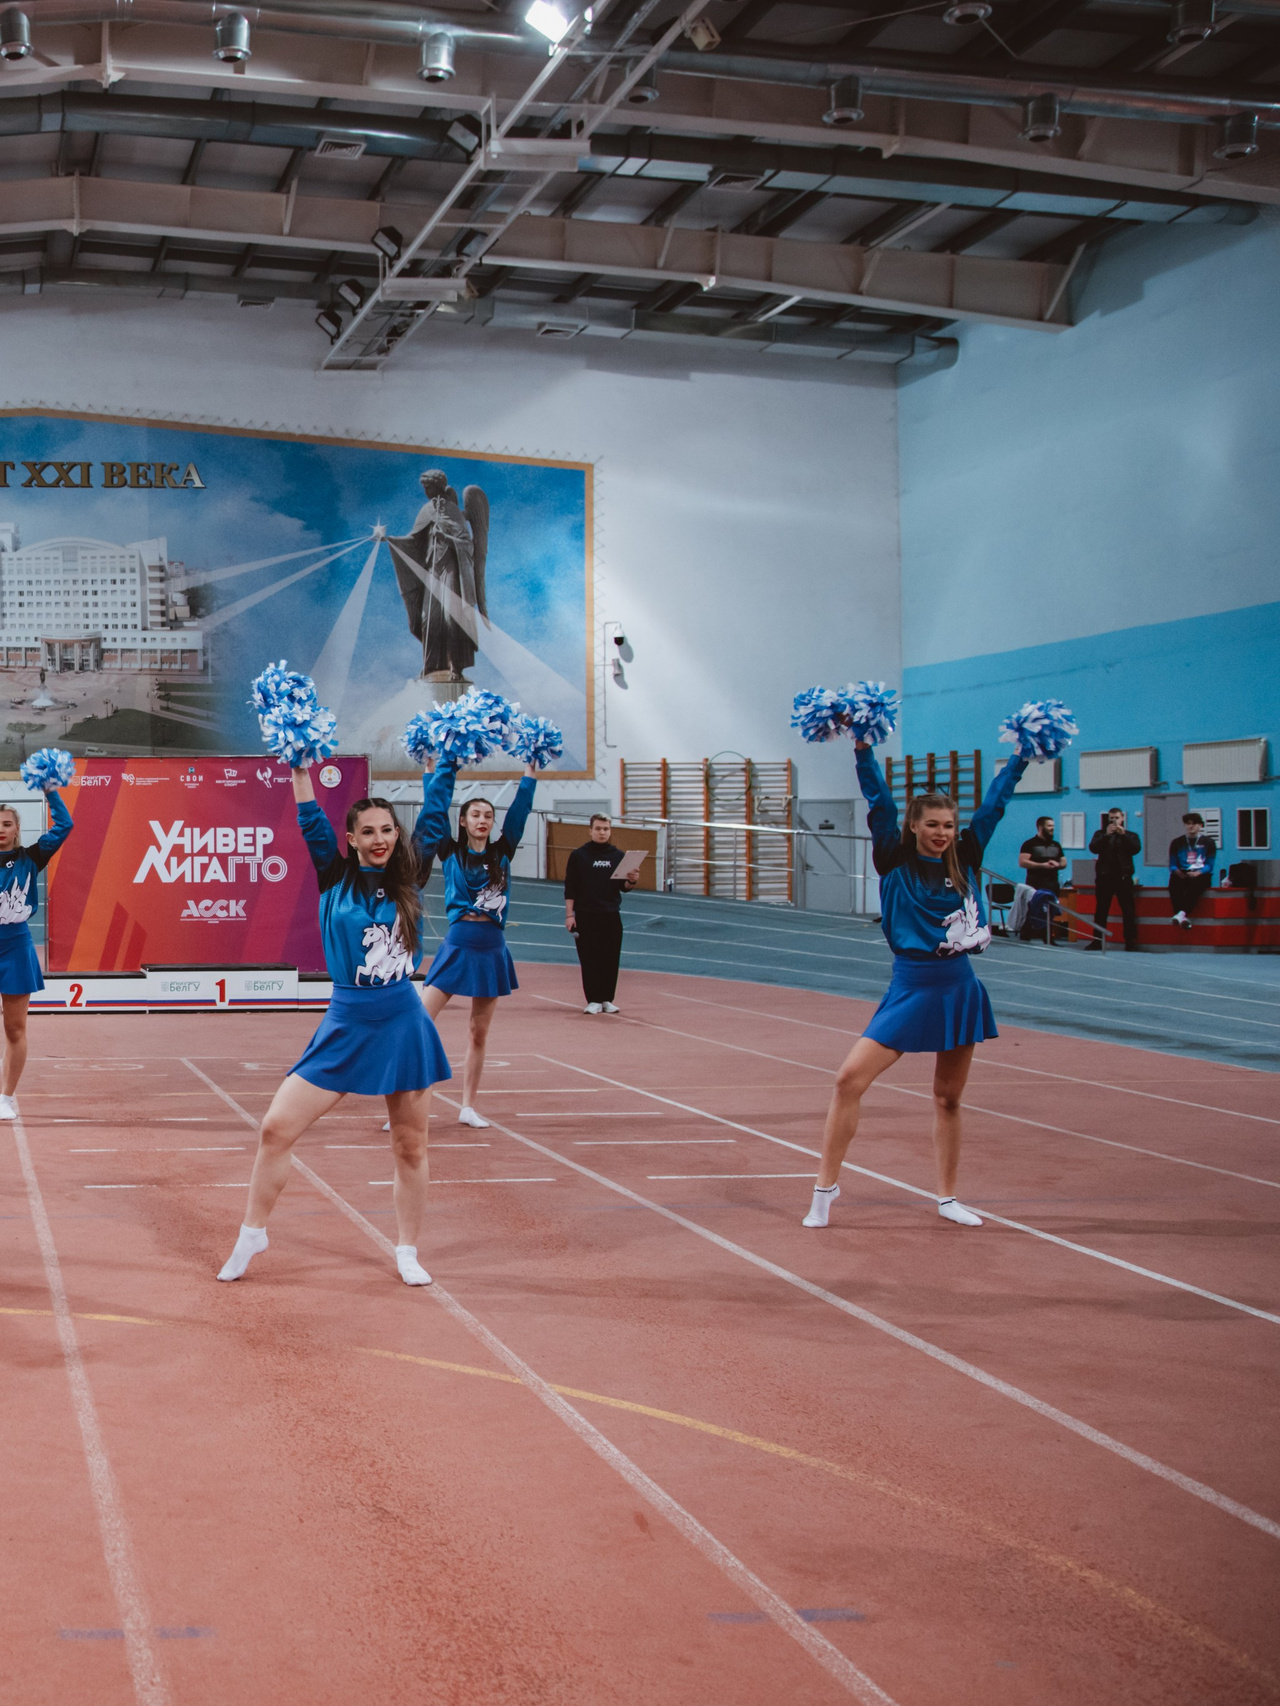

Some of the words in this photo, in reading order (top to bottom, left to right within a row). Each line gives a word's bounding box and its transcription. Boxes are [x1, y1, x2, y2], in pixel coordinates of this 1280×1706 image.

[20, 462, 92, 490] XXI
[101, 462, 207, 490] ВЕКА
[81, 776, 111, 786] БелГУ
[148, 820, 274, 856] УНИВЕР
[180, 899, 247, 917] АССК
[69, 983, 83, 1008] 2
[169, 981, 200, 992] БелГУ
[215, 978, 228, 1003] 1
[253, 980, 284, 991] БелГУ
